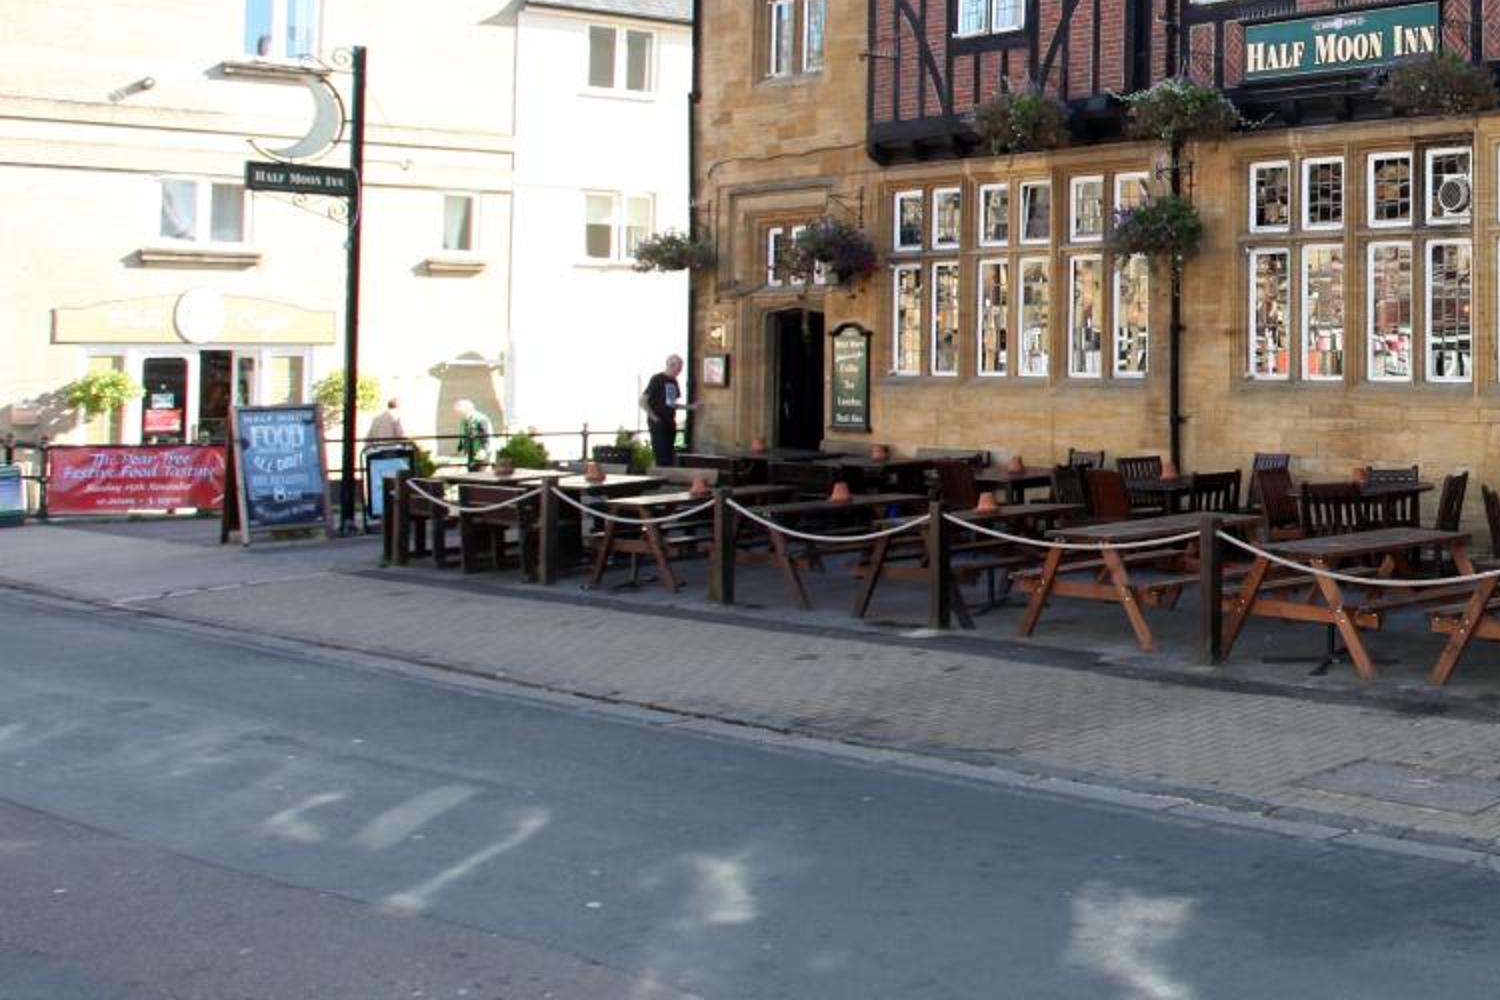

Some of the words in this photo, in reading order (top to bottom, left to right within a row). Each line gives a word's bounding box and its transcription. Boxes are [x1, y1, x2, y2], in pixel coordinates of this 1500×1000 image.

[1247, 41, 1304, 72] HALF
[1315, 32, 1383, 65] MOON
[1393, 25, 1435, 56] INN
[255, 170, 285, 183] HALF
[289, 172, 321, 185] MOON
[250, 424, 305, 448] FOOD
